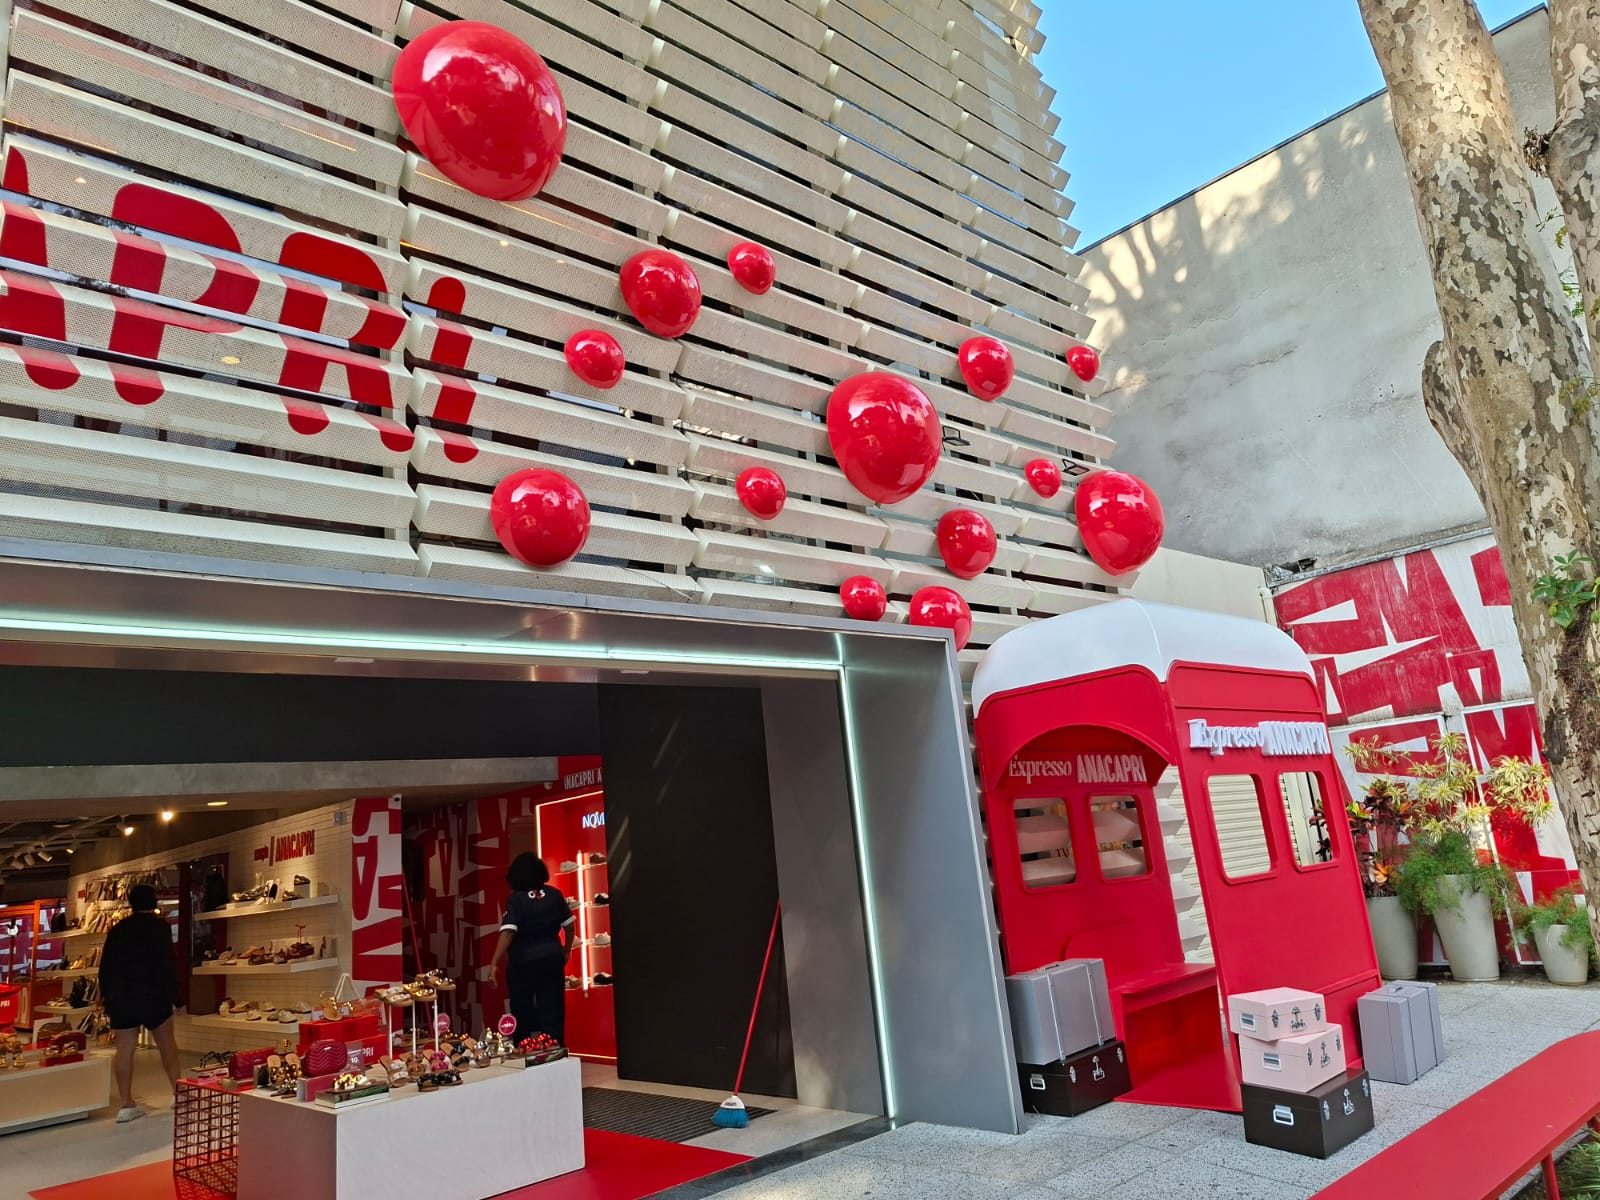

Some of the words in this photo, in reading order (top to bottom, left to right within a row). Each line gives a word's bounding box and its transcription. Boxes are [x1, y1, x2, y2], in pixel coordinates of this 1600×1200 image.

[1188, 718, 1264, 755] Expresso
[1259, 721, 1331, 755] ANACAPRI
[1008, 754, 1072, 784] Expresso
[1077, 753, 1147, 783] ANACAPRI
[275, 829, 315, 862] ANACAPRI
